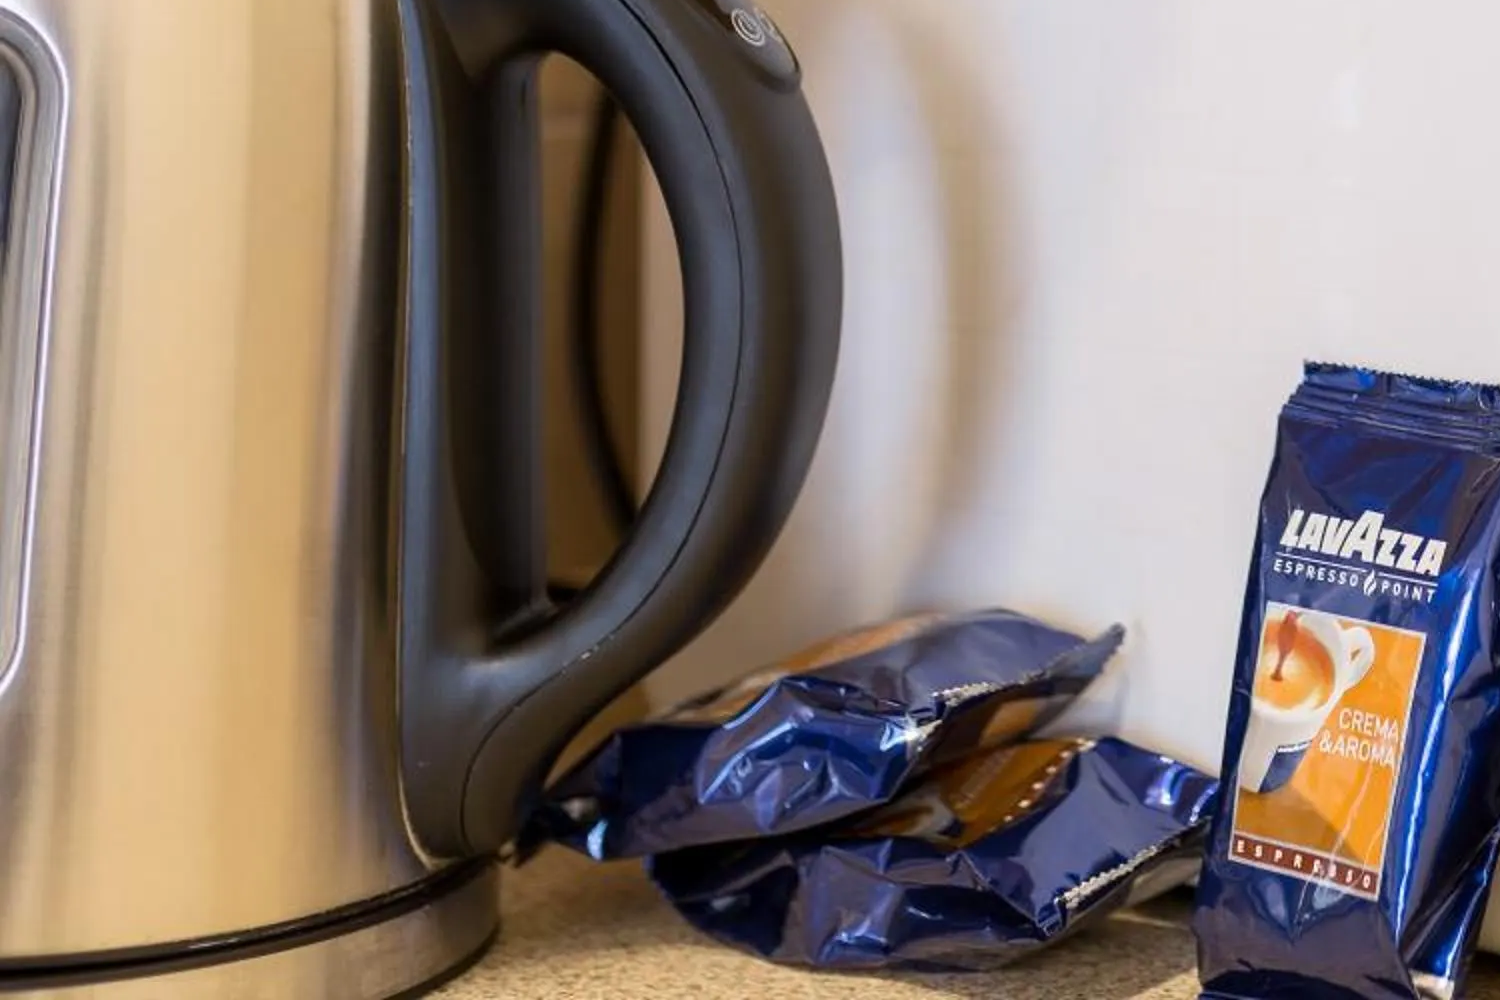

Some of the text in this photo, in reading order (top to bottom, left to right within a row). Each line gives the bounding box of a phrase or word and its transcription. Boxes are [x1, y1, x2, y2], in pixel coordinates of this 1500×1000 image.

[1279, 508, 1448, 577] LAVAZZA
[1273, 558, 1438, 604] ESPRESSO POINT
[1339, 707, 1399, 743] CREMA
